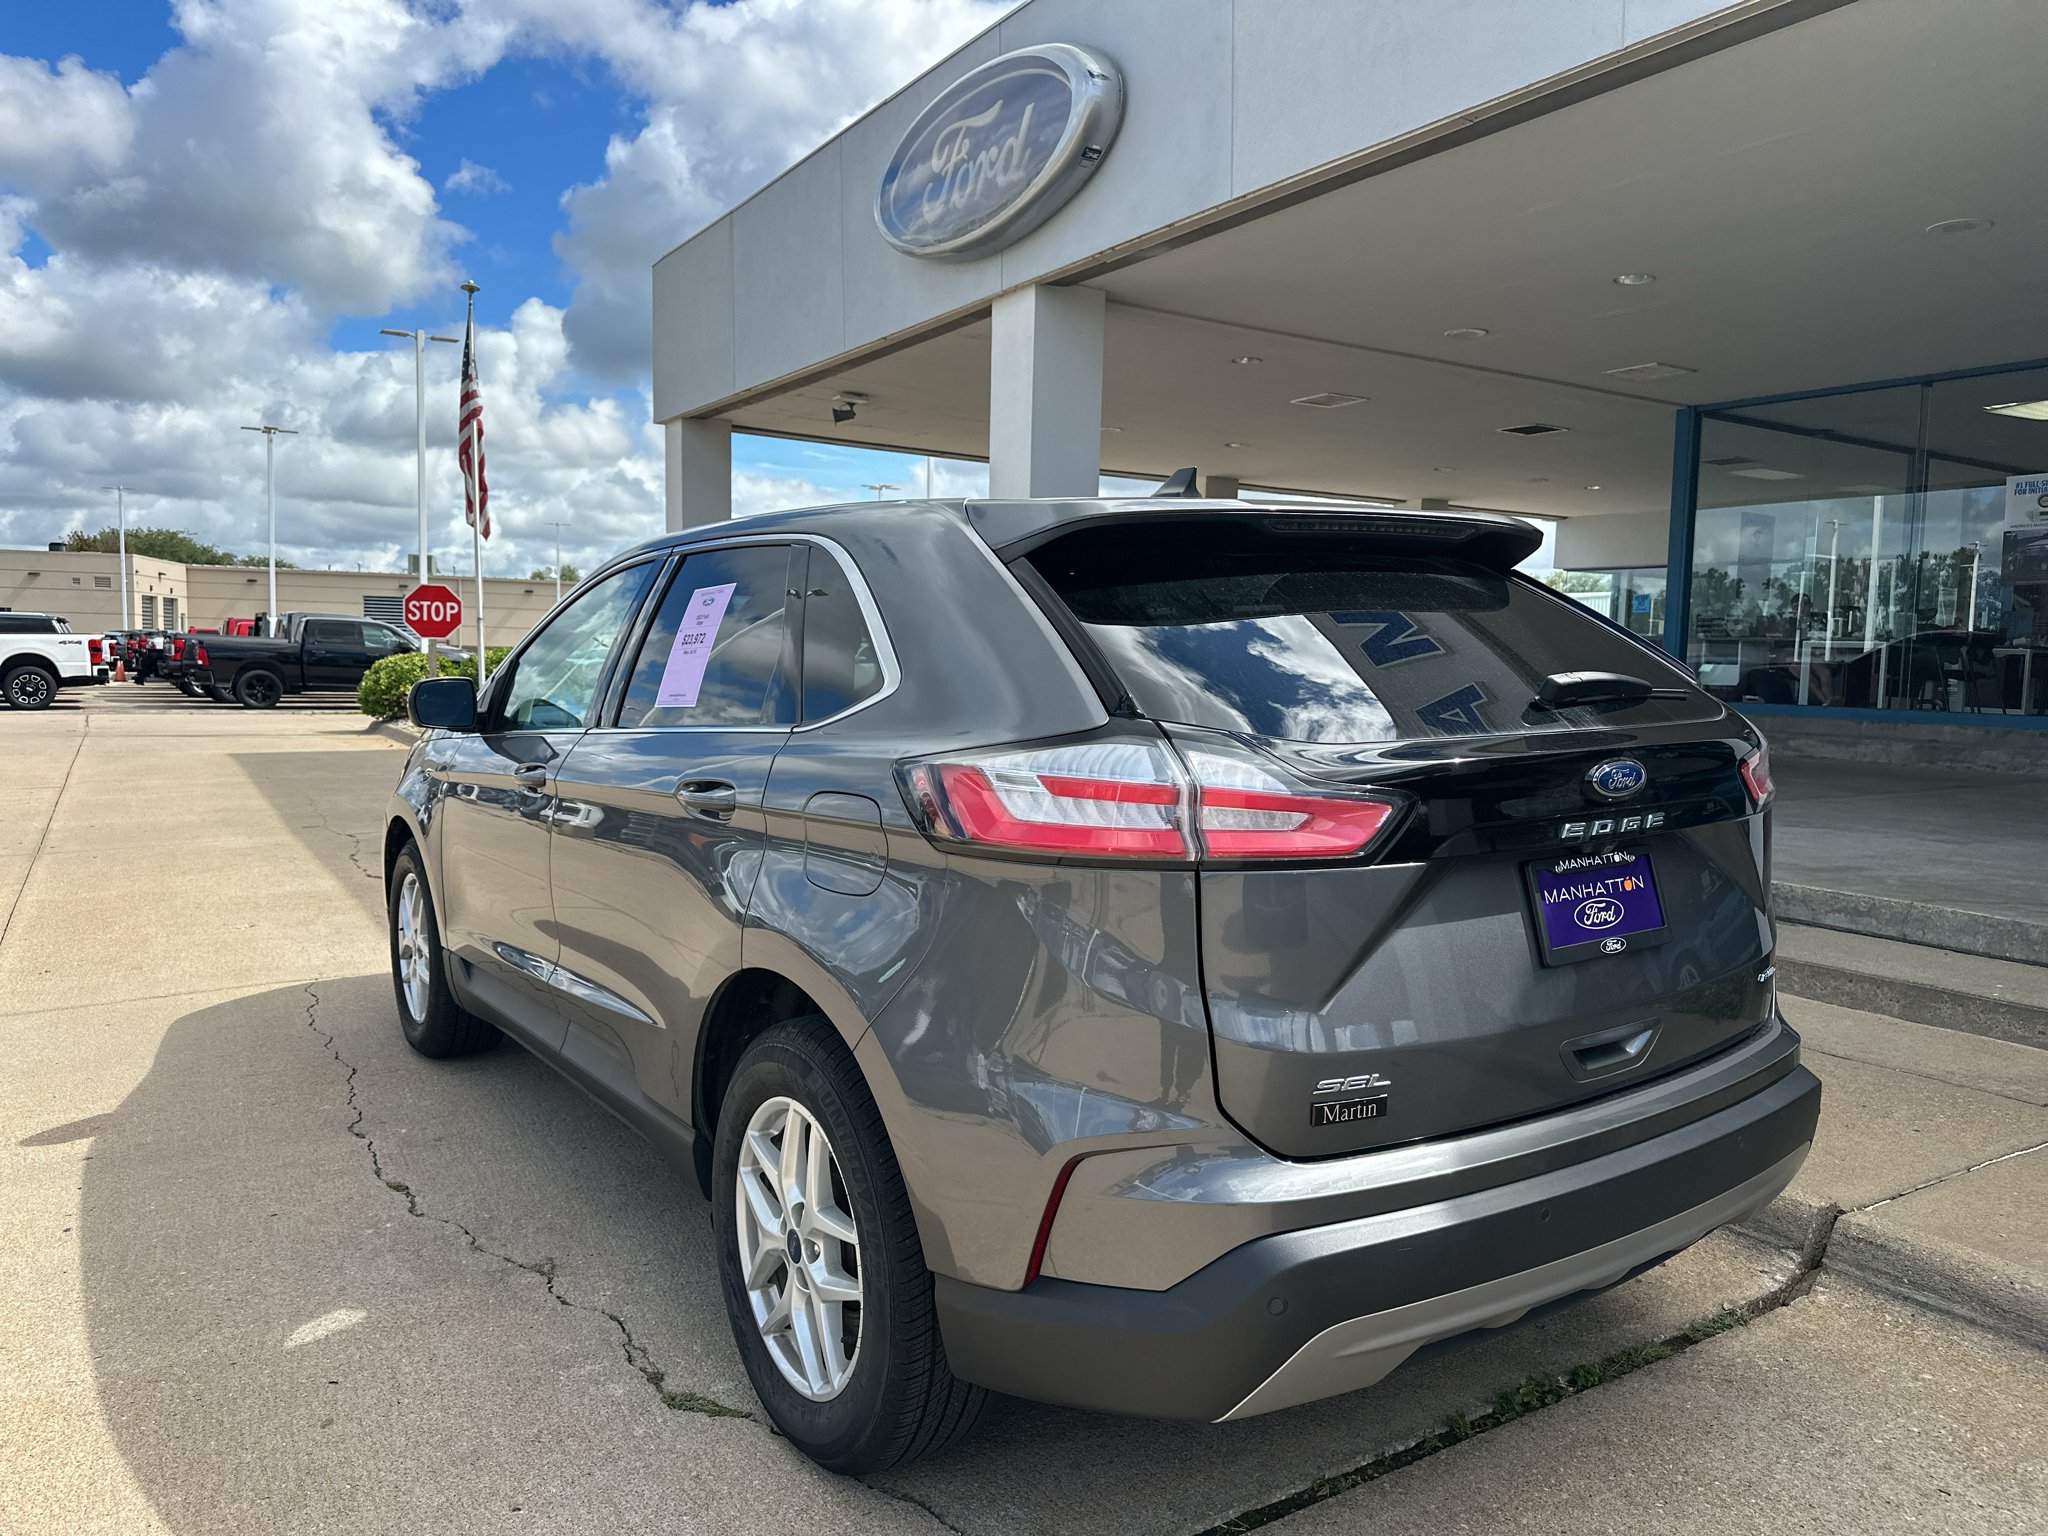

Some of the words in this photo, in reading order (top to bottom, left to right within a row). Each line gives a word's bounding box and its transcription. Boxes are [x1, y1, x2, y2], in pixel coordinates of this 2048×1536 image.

[922, 99, 1036, 224] Ford
[408, 600, 459, 622] STOP
[1608, 768, 1637, 790] Ford
[1561, 811, 1666, 839] EDGE
[1583, 902, 1616, 925] Ford
[1605, 940, 1622, 952] Ford
[1312, 1073, 1392, 1095] SEL
[1323, 1100, 1377, 1124] Martin
